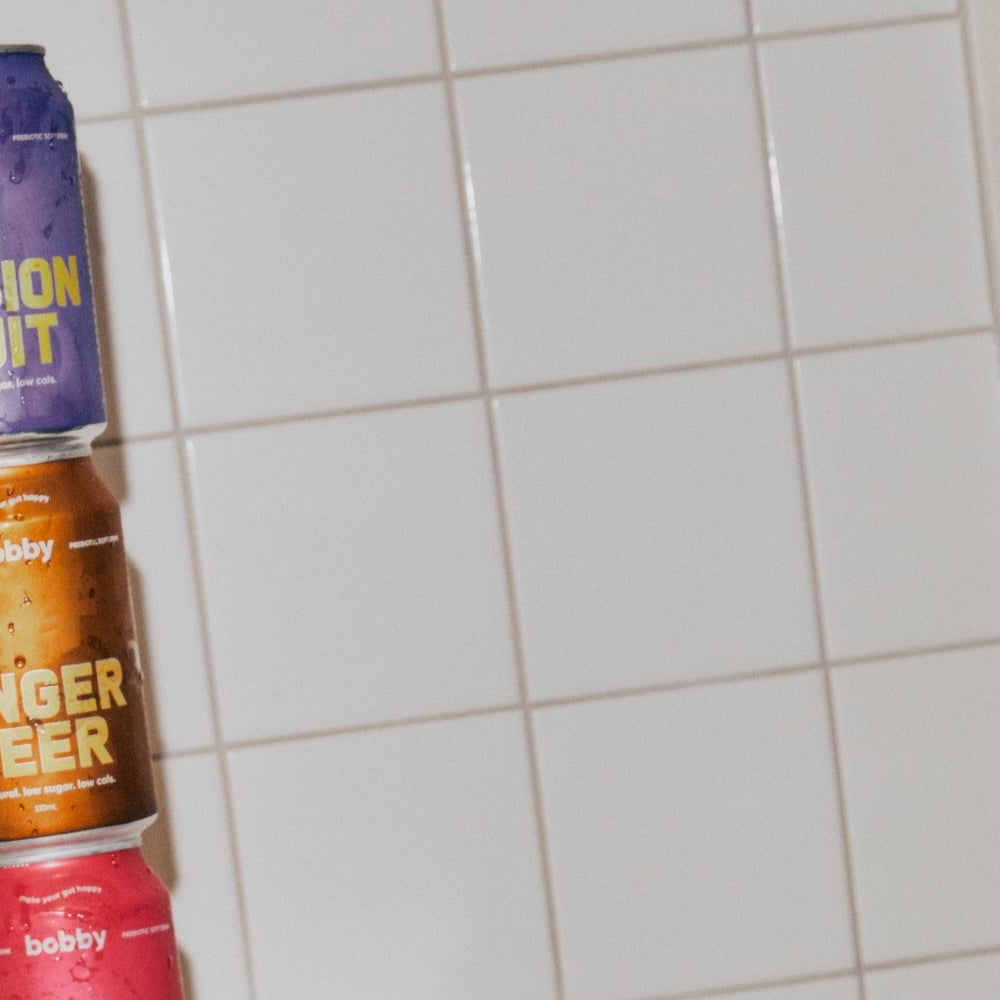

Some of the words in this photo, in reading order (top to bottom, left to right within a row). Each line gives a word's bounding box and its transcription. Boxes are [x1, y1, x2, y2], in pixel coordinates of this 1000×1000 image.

[22, 786, 42, 796] low
[77, 778, 95, 788] low
[24, 928, 107, 957] bobby
